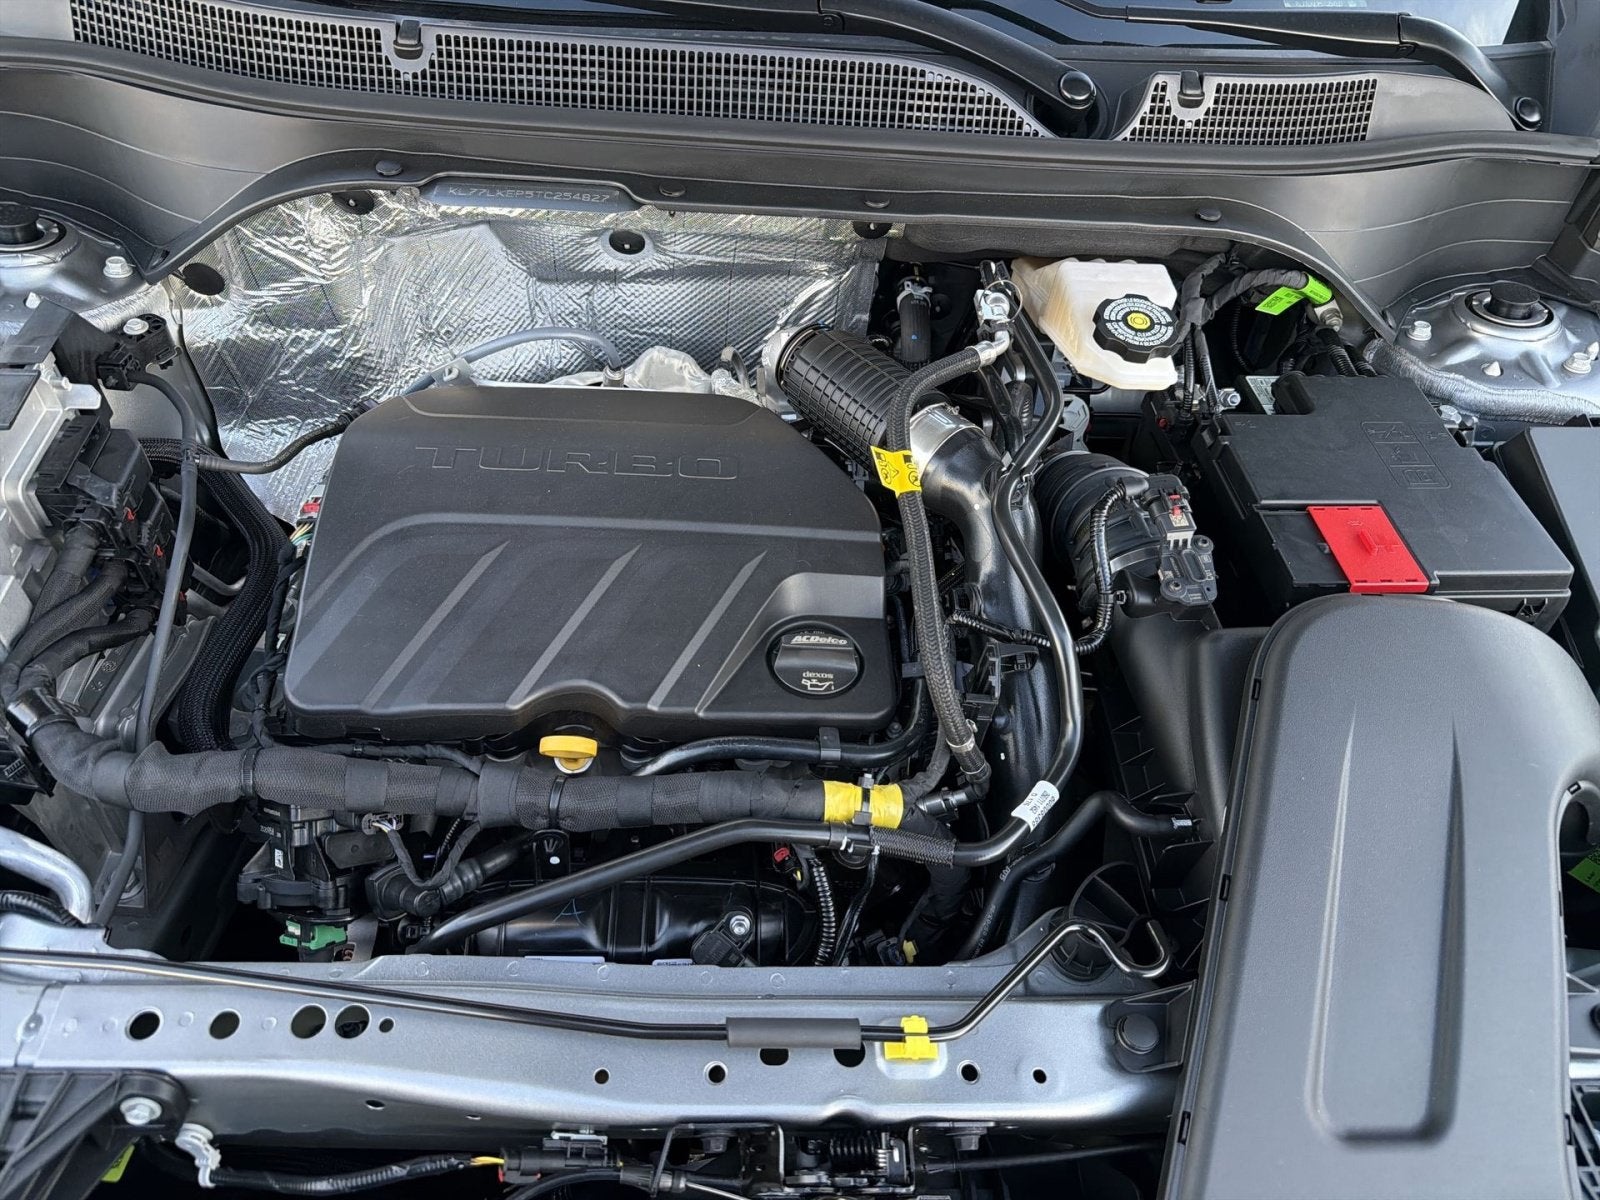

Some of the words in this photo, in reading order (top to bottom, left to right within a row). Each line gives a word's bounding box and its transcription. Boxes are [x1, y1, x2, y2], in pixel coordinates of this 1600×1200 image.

[415, 446, 737, 480] TURBO
[790, 635, 848, 645] ACDelco
[802, 670, 834, 679] dexos
